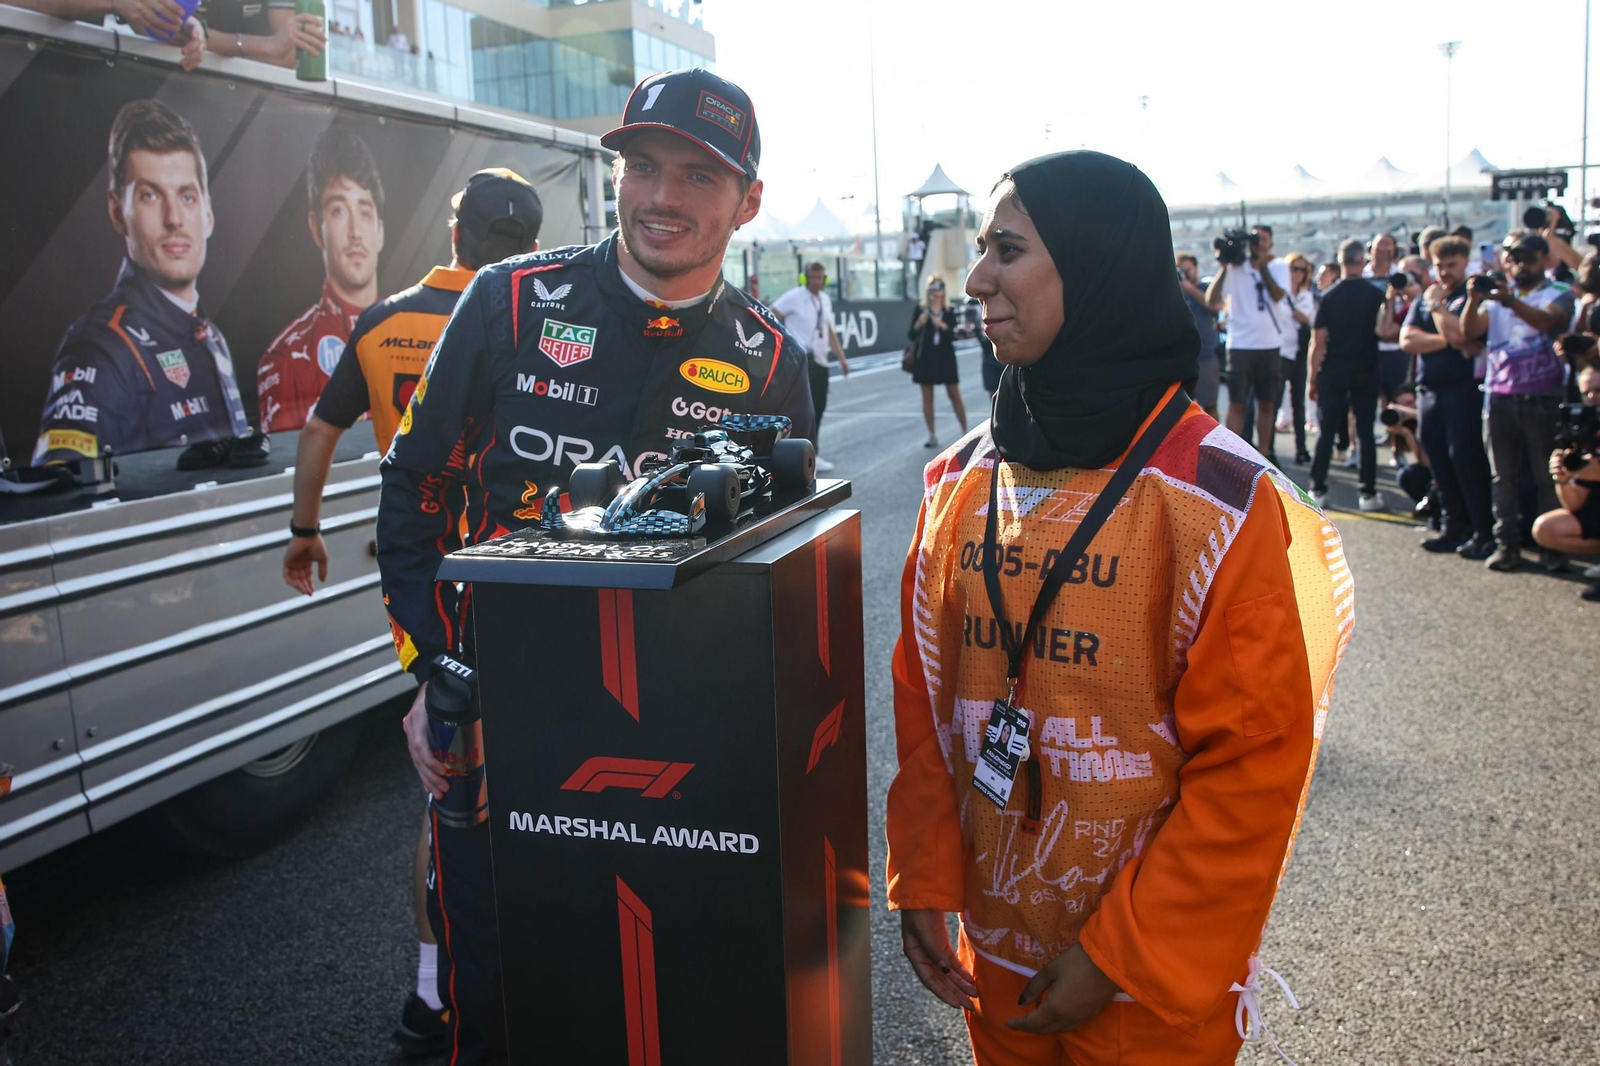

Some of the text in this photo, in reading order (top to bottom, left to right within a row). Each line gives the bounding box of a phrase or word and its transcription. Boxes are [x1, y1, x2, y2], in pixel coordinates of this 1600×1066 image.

[641, 83, 666, 111] 1
[705, 96, 741, 120] ORACLE
[1497, 174, 1563, 189] ETIHAD
[531, 301, 566, 311] CASTORE
[548, 322, 591, 344] TAG
[831, 310, 878, 350] HAD
[379, 337, 436, 350] McLar
[543, 338, 590, 365] HEUER
[517, 373, 575, 401] Mobil
[698, 366, 744, 388] RAUCH
[509, 425, 669, 481] ORAC
[440, 655, 473, 678] YETI
[1040, 715, 1118, 748] ALL
[1040, 745, 1153, 783] TIME
[509, 811, 760, 854] MARSHAL AWARD
[1075, 819, 1126, 840] RND
